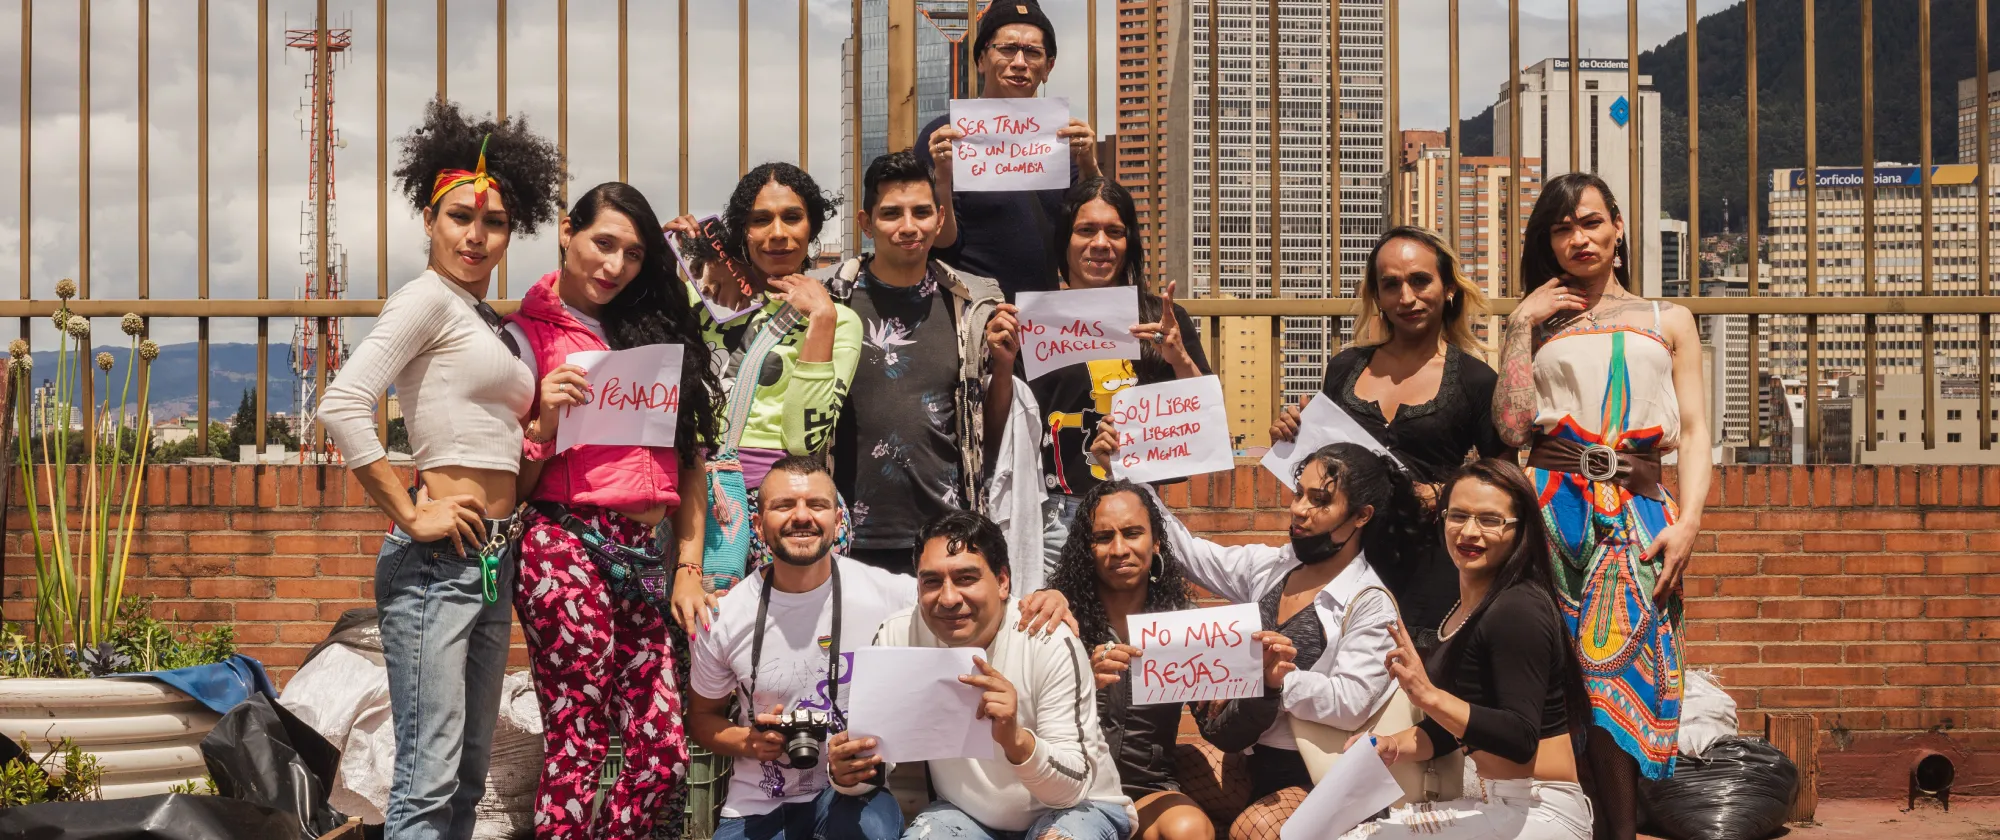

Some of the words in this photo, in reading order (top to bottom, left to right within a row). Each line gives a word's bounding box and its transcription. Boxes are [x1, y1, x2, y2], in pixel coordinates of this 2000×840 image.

[1554, 60, 1571, 68] Ban
[1579, 60, 1590, 68] de
[1590, 60, 1629, 68] Occidente
[956, 117, 988, 138] SER
[993, 115, 1041, 135] TRANS
[958, 144, 977, 160] ES
[986, 141, 1005, 157] UN
[972, 162, 986, 176] EN
[1815, 173, 1902, 186] Corficolobiana
[1020, 319, 1045, 345] NO
[1060, 319, 1104, 337] MAS
[1035, 340, 1117, 362] CARCELES
[1114, 397, 1149, 424] SOY
[1116, 431, 1135, 447] LA
[1122, 452, 1140, 468] ES
[1147, 442, 1191, 461] MENTAL
[1142, 621, 1171, 649] NO
[1184, 620, 1243, 648] MAS
